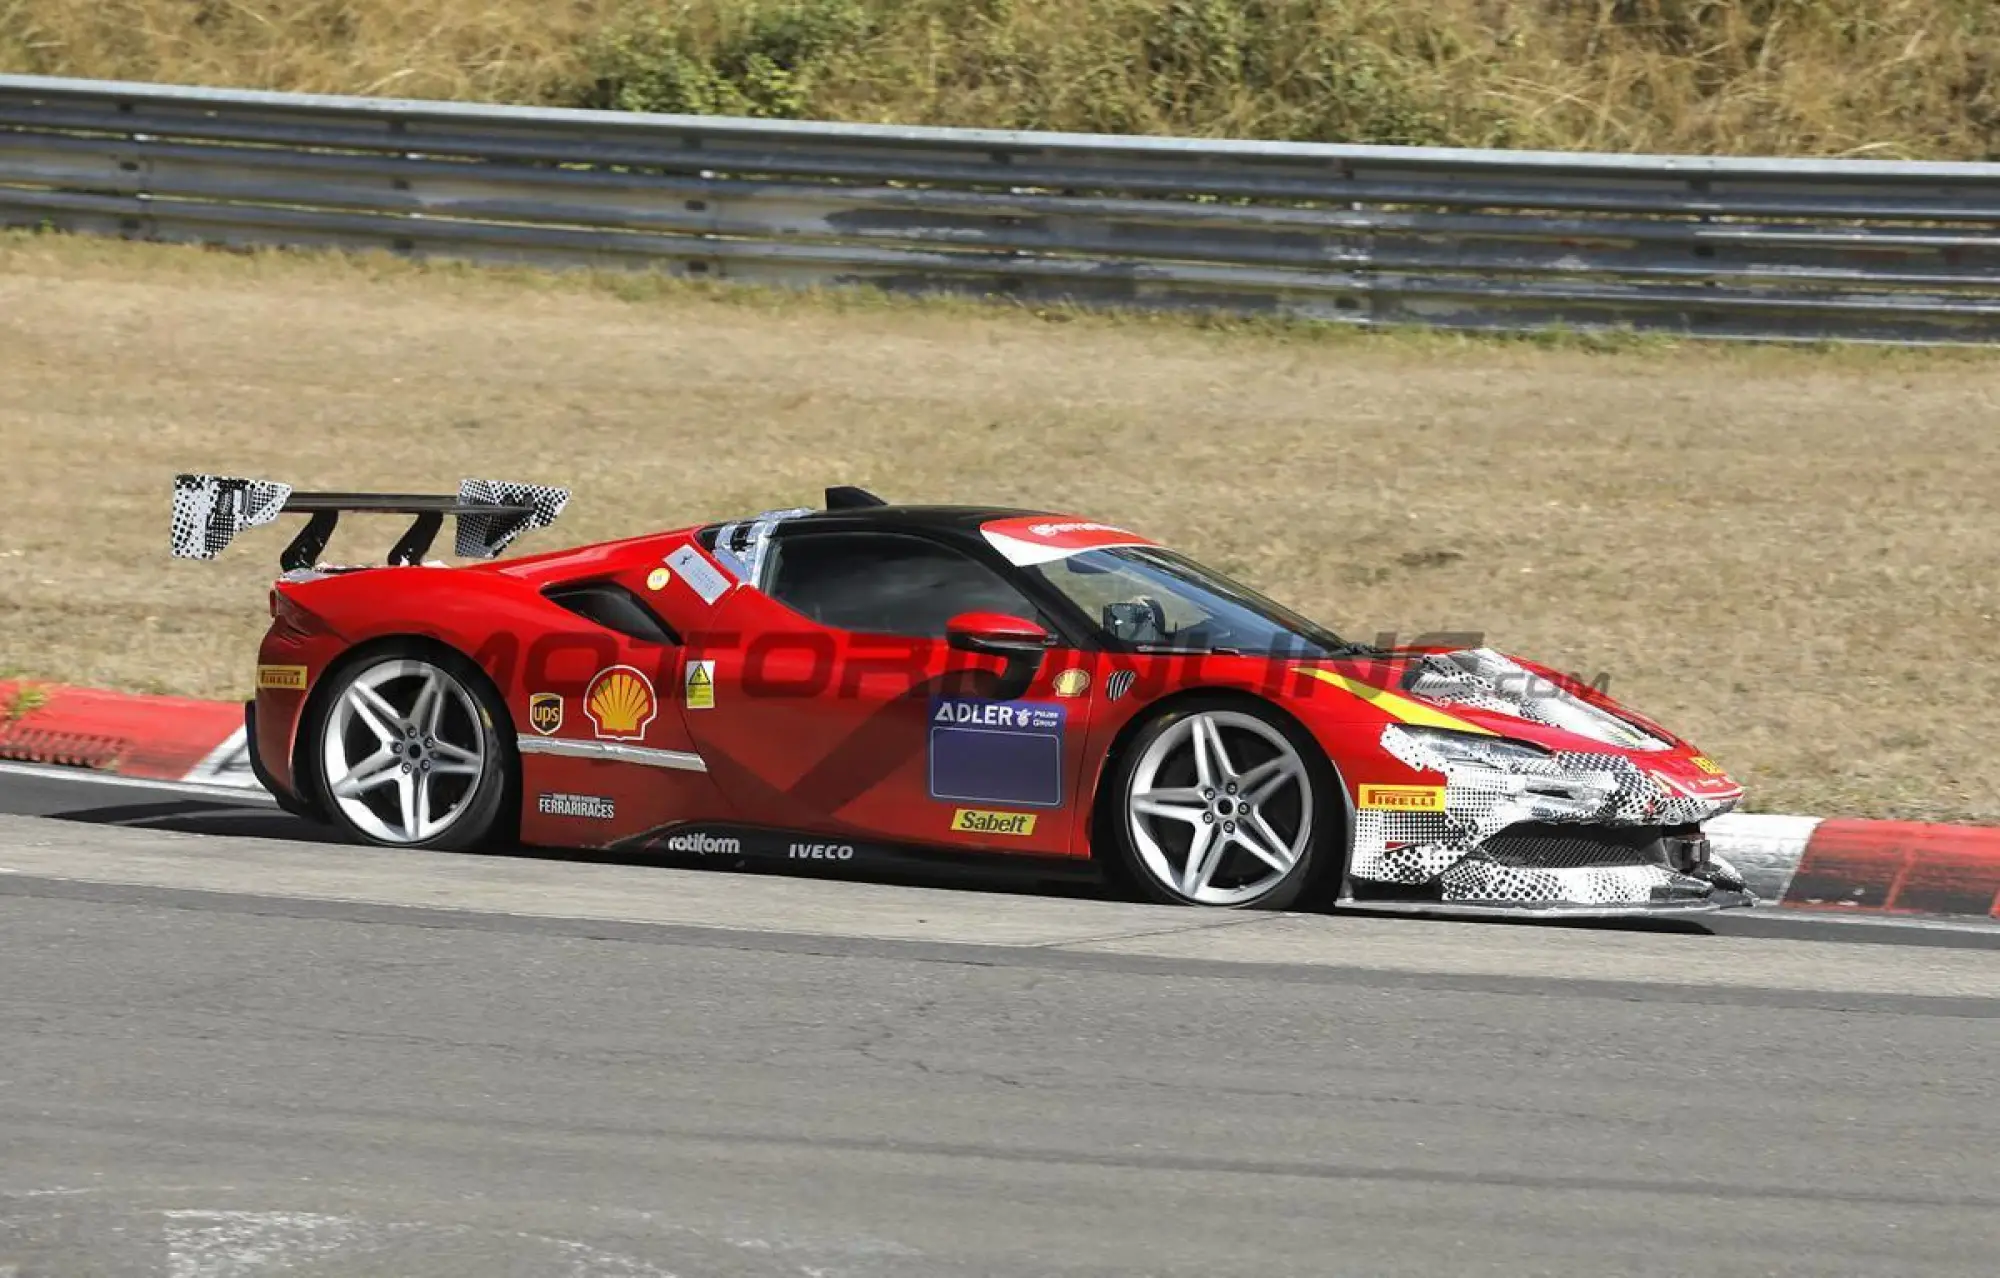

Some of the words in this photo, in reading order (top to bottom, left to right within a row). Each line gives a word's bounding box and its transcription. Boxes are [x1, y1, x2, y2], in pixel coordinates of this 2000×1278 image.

[261, 669, 301, 685] PIRELLI
[534, 706, 560, 728] ups
[934, 702, 1013, 726] ADLER
[1368, 789, 1437, 806] PIRELLI
[539, 798, 615, 819] FERRARIRACES
[960, 811, 1027, 832] Sabelt
[668, 833, 740, 855] rotiform
[789, 844, 853, 859] IVECO
